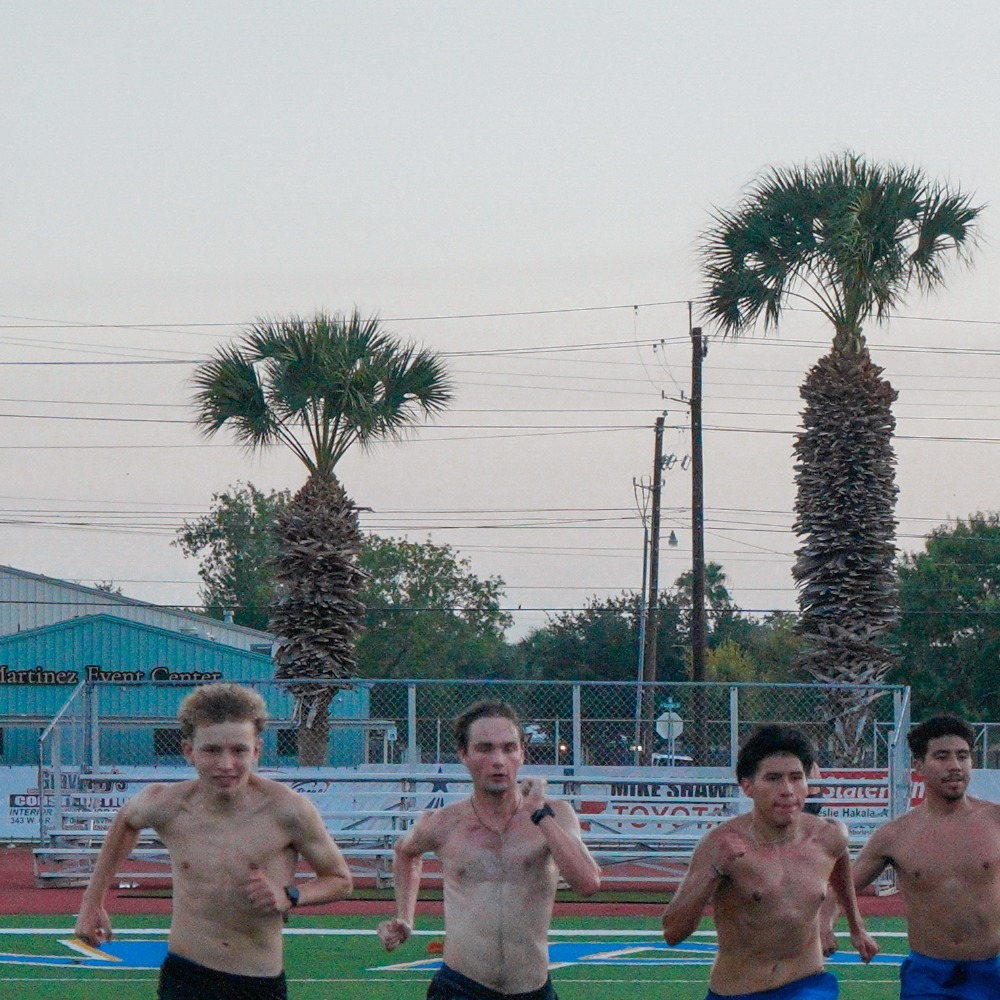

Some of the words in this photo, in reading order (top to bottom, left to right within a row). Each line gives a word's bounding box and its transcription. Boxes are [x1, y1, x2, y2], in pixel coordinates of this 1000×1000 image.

[0, 666, 78, 684] artinez
[86, 666, 144, 683] Event
[151, 667, 222, 684] Center
[611, 784, 661, 797] MIKE
[666, 784, 728, 798] SHAW
[612, 805, 724, 829] TOYOTA
